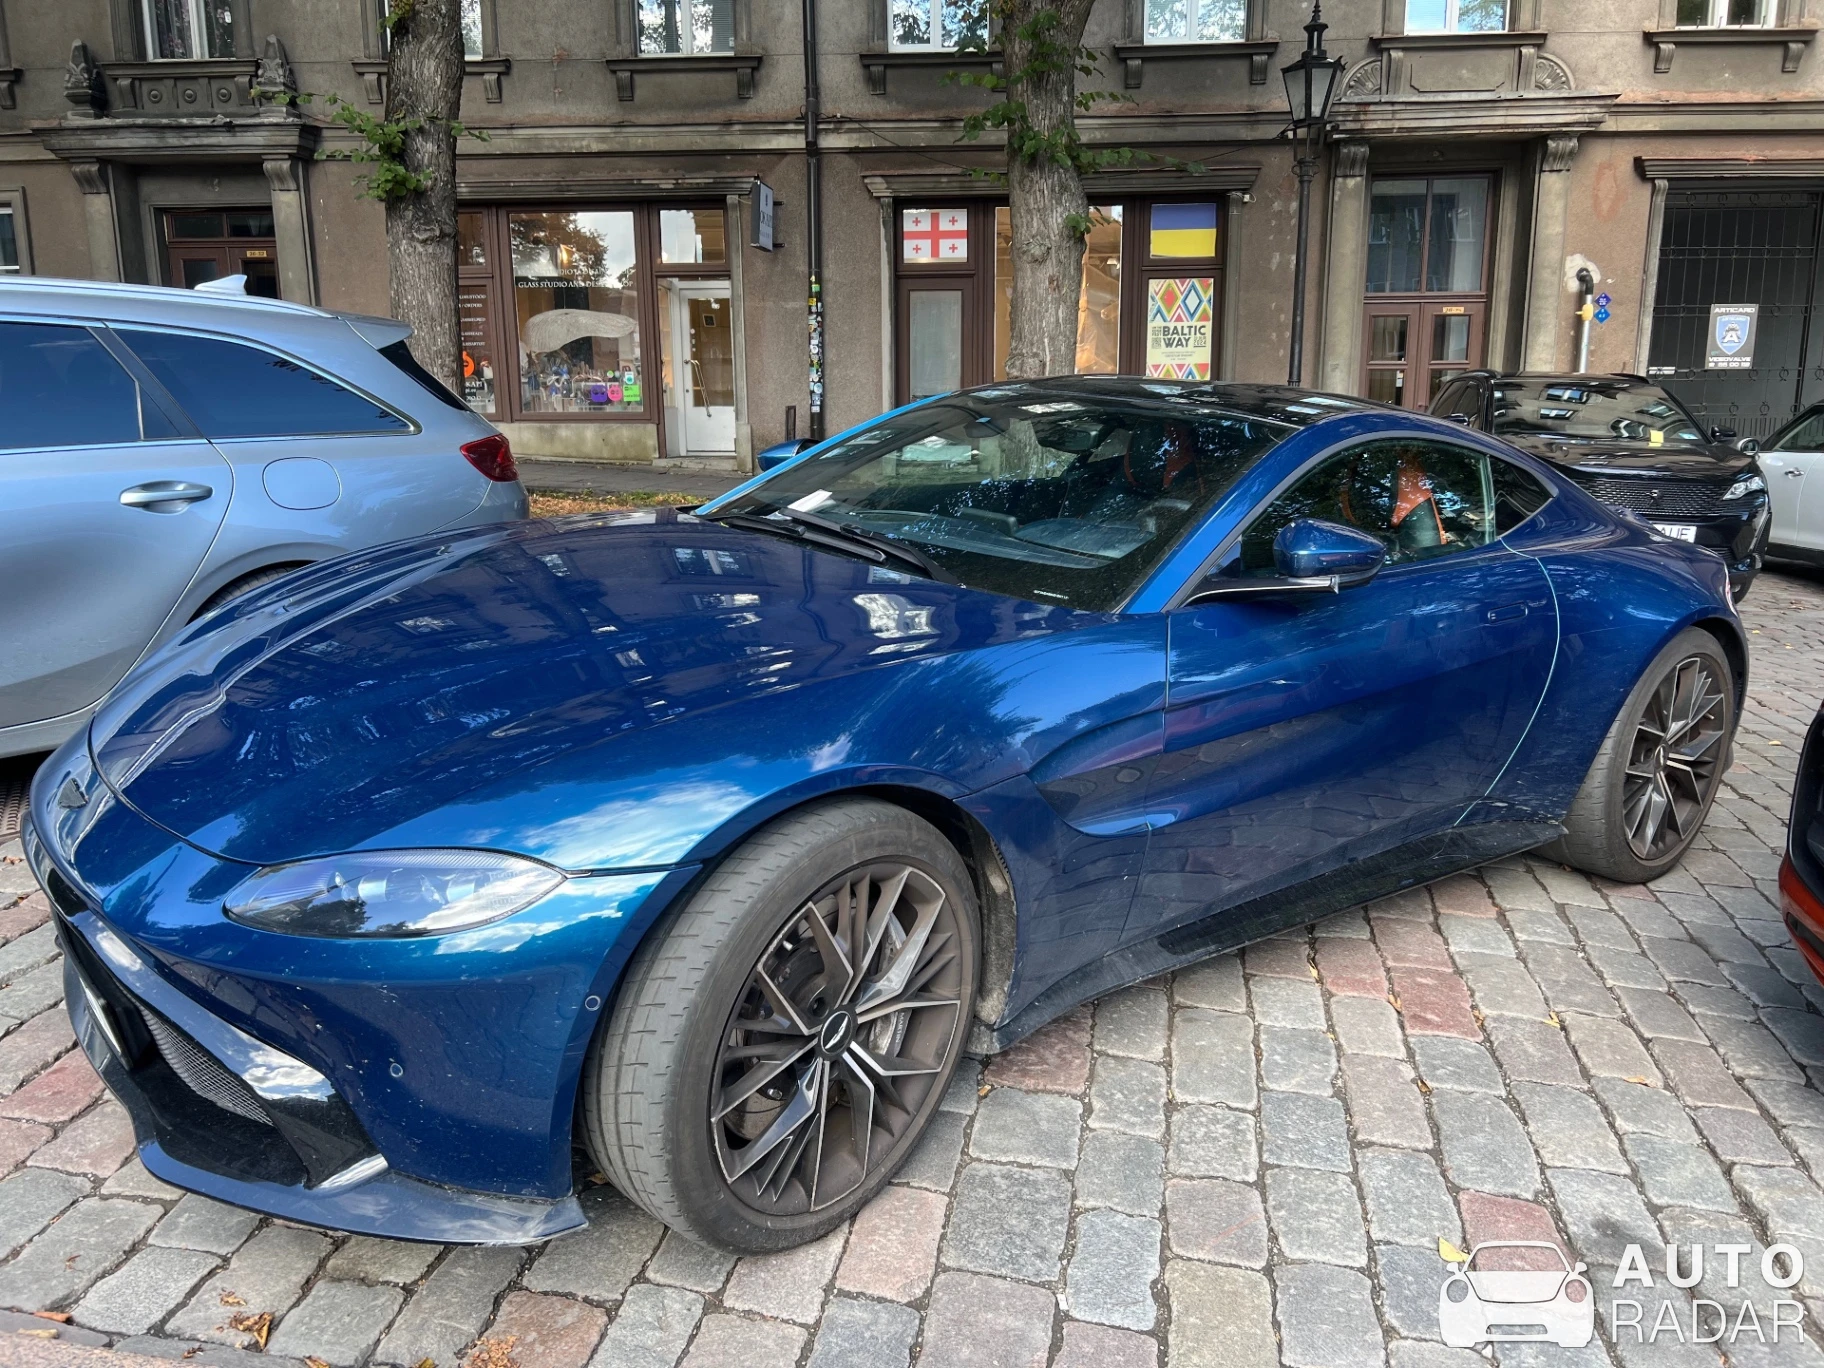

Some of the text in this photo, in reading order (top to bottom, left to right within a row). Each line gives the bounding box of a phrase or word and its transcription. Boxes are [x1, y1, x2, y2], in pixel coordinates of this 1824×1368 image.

[540, 280, 568, 288] STUDIO
[1163, 325, 1206, 336] BALTIC
[1163, 337, 1191, 348] WAY
